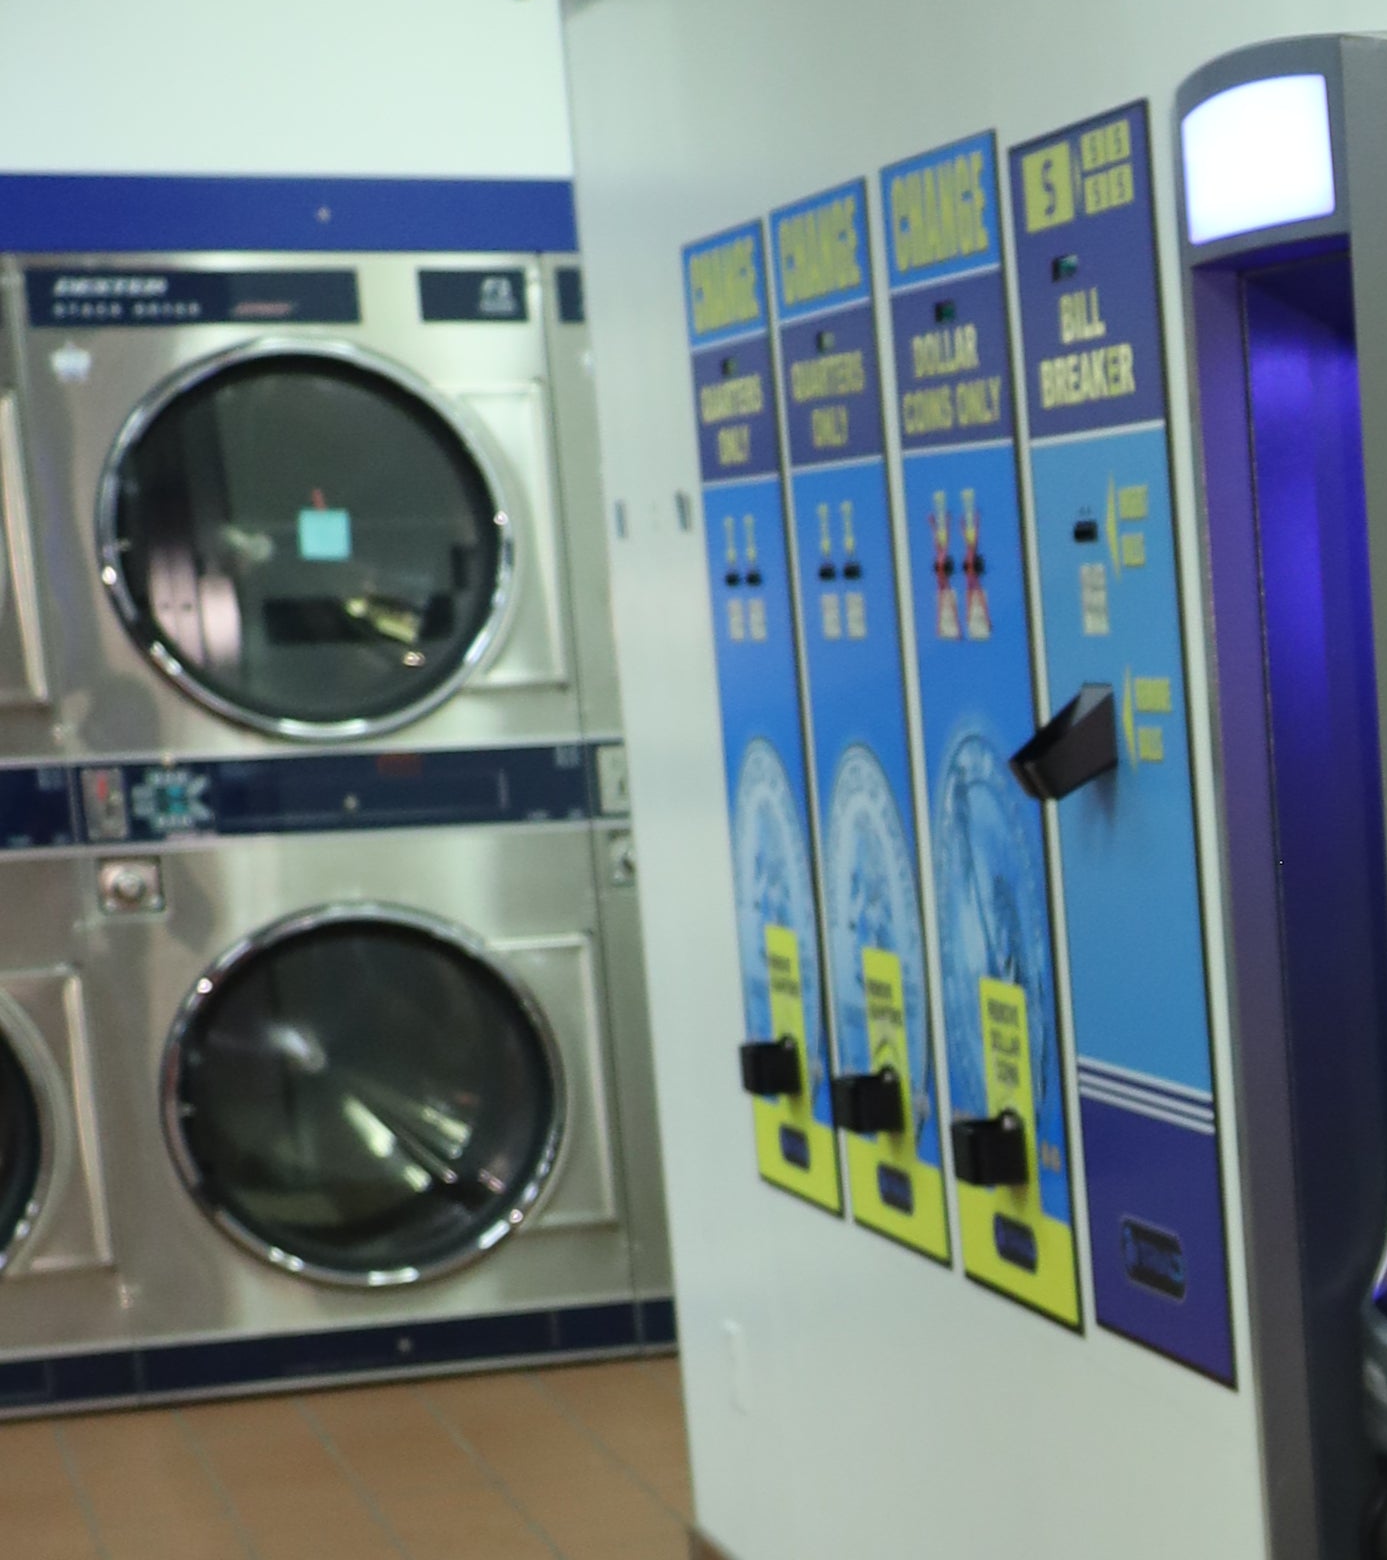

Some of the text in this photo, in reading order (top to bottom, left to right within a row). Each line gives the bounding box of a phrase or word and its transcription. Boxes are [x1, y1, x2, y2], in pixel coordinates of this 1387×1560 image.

[890, 150, 989, 275] CHANGE
[779, 194, 862, 307] CHANGE
[689, 235, 760, 336] CHANGE
[1059, 285, 1107, 345] BILL
[912, 323, 979, 379] DOLLAR
[1039, 342, 1136, 410] BREAKER
[812, 404, 848, 448] ONLY
[956, 376, 1001, 427] ONLY
